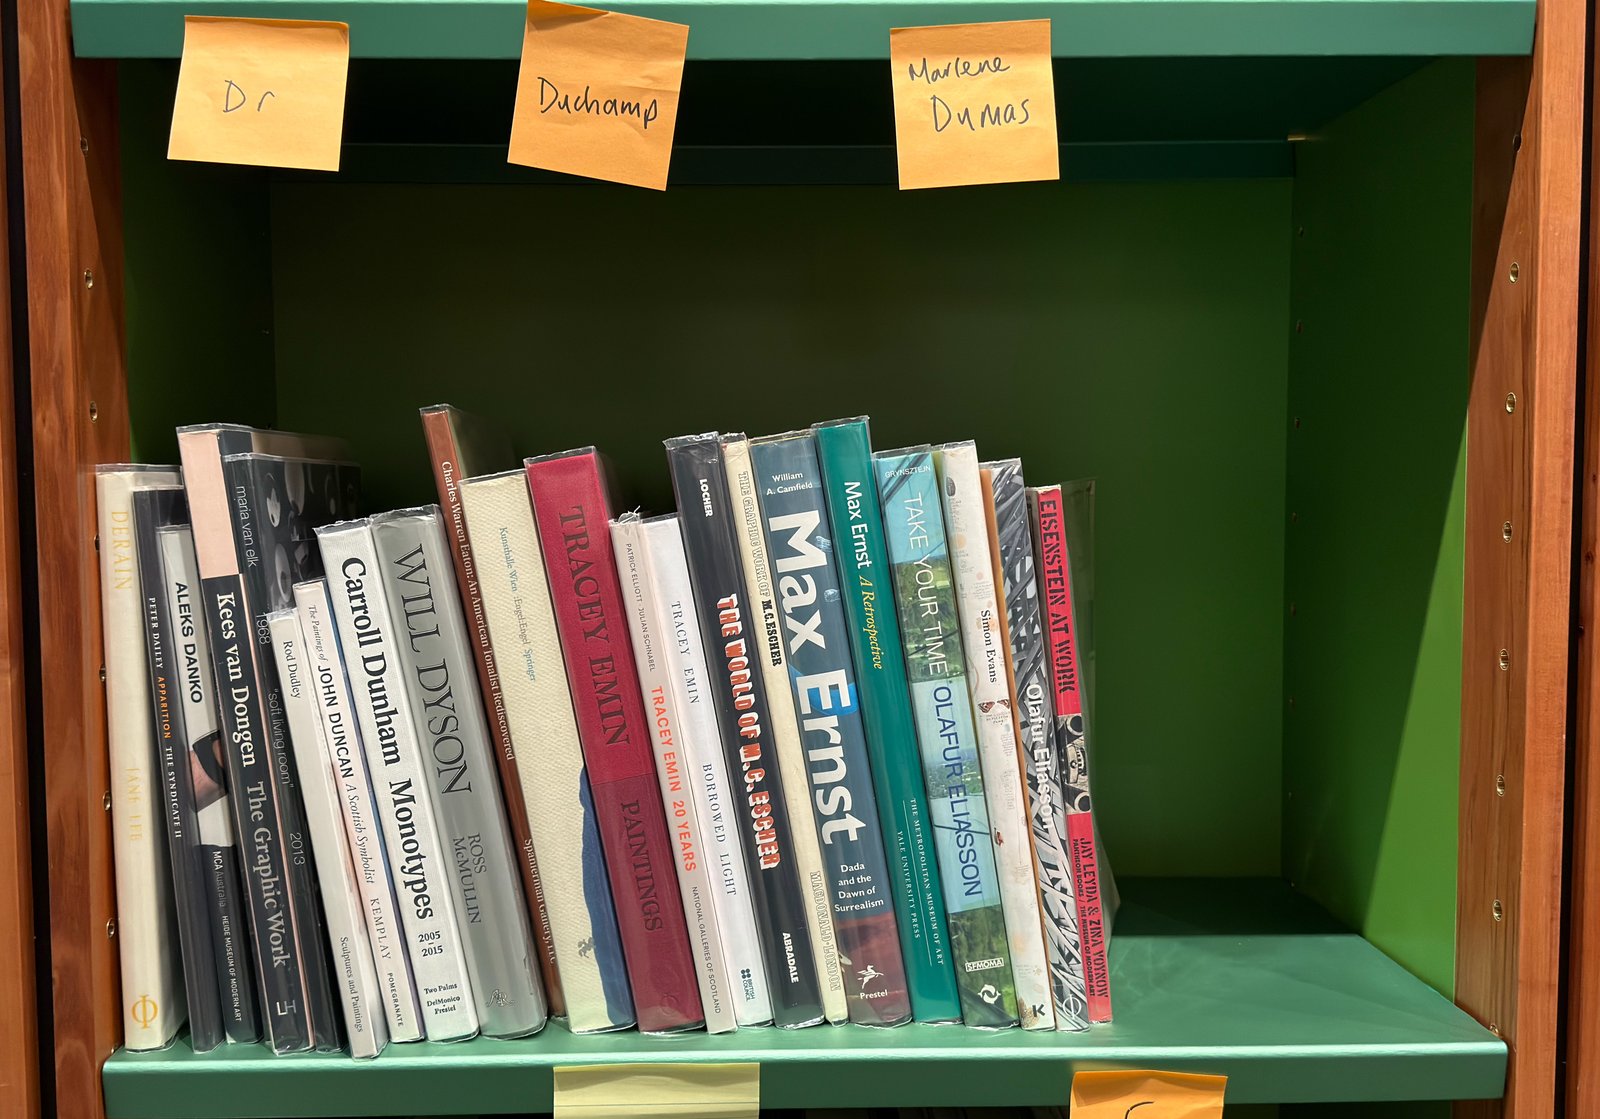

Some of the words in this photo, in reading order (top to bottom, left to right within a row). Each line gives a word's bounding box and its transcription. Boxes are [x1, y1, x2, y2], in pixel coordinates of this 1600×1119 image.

[908, 56, 1011, 84] Marlene
[223, 80, 275, 113] Dr
[537, 76, 658, 129] Duchamp
[930, 94, 1030, 133] Dumas
[441, 461, 457, 503] Charles
[738, 470, 751, 497] THE
[766, 487, 776, 496] A.
[776, 481, 814, 495] Camfield
[772, 471, 804, 483] William
[884, 464, 931, 479] GRYNSZTEJN
[235, 485, 252, 520] maria
[699, 478, 714, 518] LOCHER
[843, 480, 862, 519] Max
[241, 522, 253, 546] van
[451, 502, 466, 543] Warren
[743, 496, 760, 547] GRAPHIC
[903, 491, 929, 550] TAKE
[111, 510, 132, 591] DERAIN
[245, 548, 259, 568] elk
[460, 543, 474, 579] Eaton:
[499, 526, 515, 569] Kunsthalle
[509, 569, 519, 593] Wien
[626, 542, 637, 573] PATRICK
[751, 546, 768, 582] WORK
[851, 522, 872, 570] Ernst
[1039, 499, 1064, 607] EISENSTEIN
[393, 543, 442, 653] WILL
[467, 579, 478, 596] An
[631, 573, 643, 603] ELLIOTT
[758, 581, 771, 597] OF
[768, 509, 828, 656] Max
[859, 575, 873, 588] A
[913, 553, 939, 618] YOUR
[149, 597, 160, 630] PETER
[175, 582, 194, 638] ALEKS
[216, 591, 238, 640] Kees
[308, 604, 316, 620] The
[341, 556, 383, 649] Carroll
[638, 607, 648, 633] JULIAN
[716, 593, 743, 638] THE
[256, 612, 271, 645] 1968
[311, 620, 325, 653] Paintings
[472, 596, 489, 648] American
[559, 504, 610, 643] TRACEY
[588, 655, 630, 748] EMIN
[861, 590, 885, 670] Retrospective
[980, 609, 994, 647] Simon
[1050, 611, 1069, 635] AT
[153, 631, 164, 669] DAILEY
[224, 643, 242, 682] van
[283, 639, 295, 665] Rod
[523, 648, 536, 682] Springer
[643, 633, 656, 672] SCHNABEL
[923, 620, 949, 677] TIME
[985, 648, 997, 684] Evans
[1053, 639, 1075, 695] WORK
[183, 643, 203, 704] DANKO
[287, 664, 301, 699] Dudley
[317, 664, 339, 708] JOHN
[485, 647, 500, 691] Tonalist
[724, 637, 756, 711] WORLD
[157, 675, 171, 740] APPARITION
[231, 685, 256, 768] Dongen
[361, 652, 401, 767] Dunham
[415, 658, 472, 795] DYSON
[492, 692, 516, 761] Rediscovered
[651, 685, 674, 747] TRACEY
[737, 711, 762, 739] OF
[1026, 683, 1051, 745] Olafur
[271, 717, 286, 750] living
[328, 712, 355, 779] DUNCAN
[671, 600, 691, 657] TRACEY
[683, 667, 700, 704] EMIN
[702, 763, 726, 844] BORROWED
[719, 853, 737, 896] LIGHT
[933, 685, 964, 779] OLAFUR
[165, 746, 174, 767] THE
[663, 750, 682, 793] EMIN
[795, 668, 867, 845] Ernst
[167, 771, 181, 827] SYNDICATE
[246, 780, 267, 822] The
[346, 783, 357, 793] A
[1032, 747, 1054, 828] Eliasson
[348, 794, 365, 834] Scottish
[672, 799, 686, 819] 20
[910, 798, 919, 817] THE
[289, 831, 306, 866] 2013
[356, 834, 376, 884] Symbolist
[389, 777, 434, 920] Monotypes
[467, 832, 487, 875] ROSS
[677, 821, 697, 873] YEARS
[897, 831, 906, 854] YALE
[914, 819, 931, 890] METROPOLITAN
[948, 783, 983, 897] ELIASSON
[1073, 838, 1082, 874] PANTHEON
[1080, 837, 1094, 860] JAY
[212, 850, 224, 871] MCA
[252, 826, 283, 909] Graphic
[523, 838, 544, 903] Spanierman
[620, 799, 663, 932] PAINTINGS
[840, 862, 865, 874] Dada
[452, 837, 482, 924] McMULLIN
[838, 876, 855, 887] and
[856, 873, 872, 885] the
[838, 888, 861, 900] Dawn
[864, 886, 876, 896] of
[901, 855, 916, 910] UNIVERSITY
[1076, 874, 1085, 898] BOOKS
[1083, 863, 1098, 903] LEYDA
[692, 886, 704, 922] NATIONAL
[834, 897, 884, 913] Surrealism
[926, 891, 938, 931] MUSEUM
[222, 915, 231, 936] HEIDE
[266, 910, 291, 968] Work
[418, 930, 441, 943] 2005
[698, 923, 711, 961] GALLERIES
[911, 911, 921, 939] PRESS
[933, 932, 941, 945] OF
[1081, 917, 1090, 945] MUSEUM
[1089, 918, 1102, 947] ZINA
[225, 937, 236, 967] MUSEUM
[340, 936, 354, 979] Sculptures
[370, 897, 392, 960] KEMPLAY
[387, 972, 404, 1027] POMEGRANATE
[421, 945, 443, 957] 2015
[706, 962, 714, 972] OF
[782, 931, 799, 984] ABRADALE
[935, 948, 944, 965] ART
[965, 957, 1004, 972] SFMOMA
[1086, 954, 1094, 984] MODERN
[228, 967, 236, 977] OF
[348, 979, 358, 994] and
[423, 987, 438, 995] Two
[438, 983, 458, 992] Palms
[742, 979, 751, 1002] COUNCIL
[747, 978, 756, 1000] BRITISH
[1093, 949, 1109, 998] VOYNOW
[230, 978, 240, 1008] MODERN
[434, 1004, 456, 1015] Prestel
[708, 973, 721, 1014] SCOTLAND
[859, 989, 888, 1000] Prestel
[234, 1008, 242, 1021] ART
[351, 994, 363, 1033] Paintings
